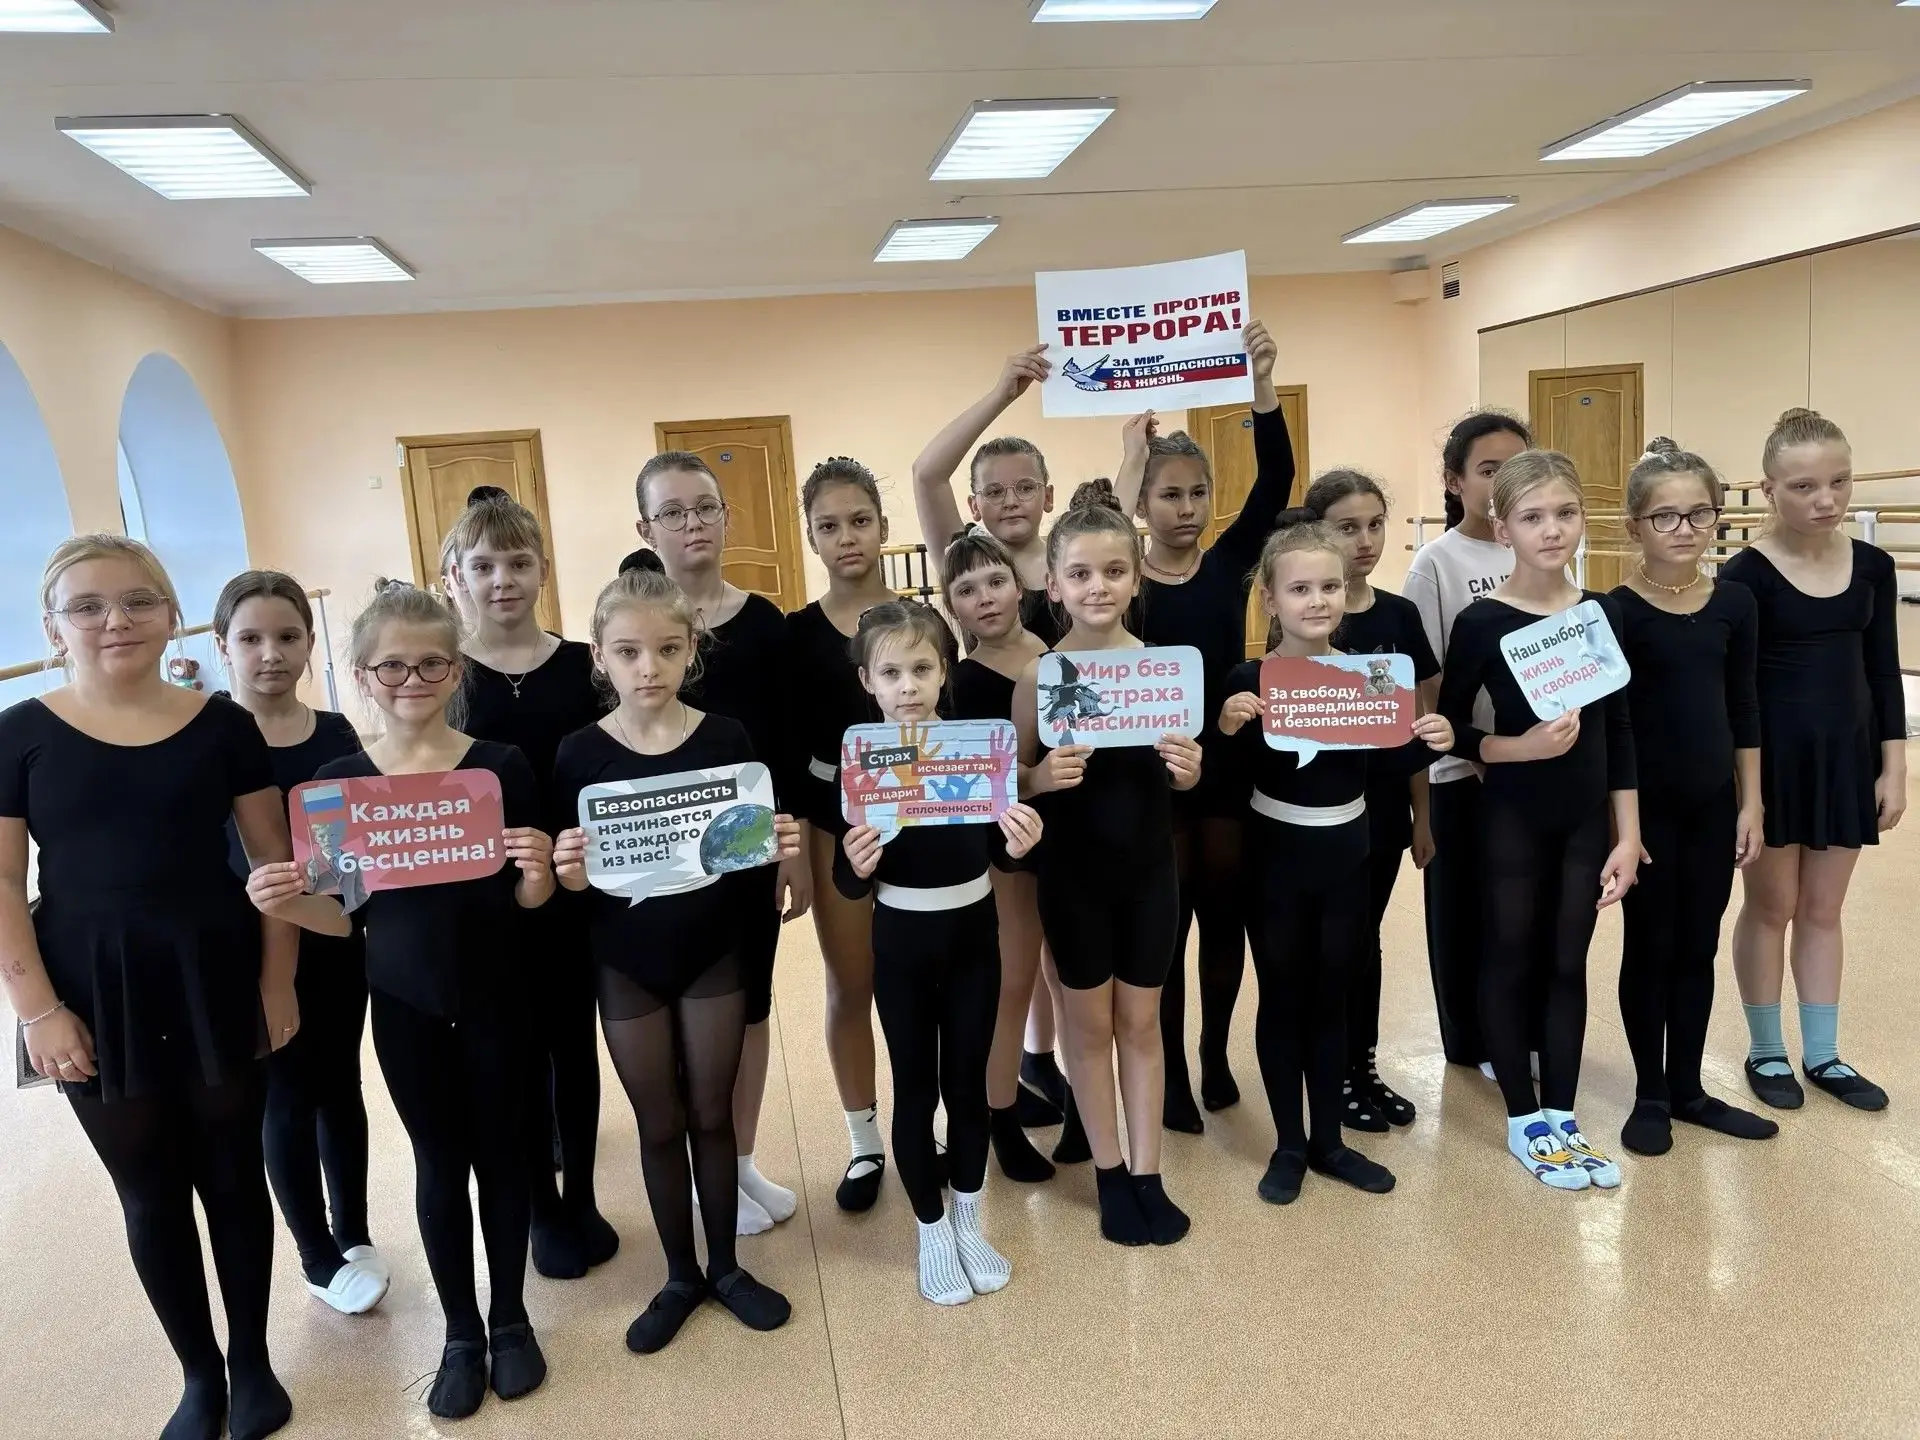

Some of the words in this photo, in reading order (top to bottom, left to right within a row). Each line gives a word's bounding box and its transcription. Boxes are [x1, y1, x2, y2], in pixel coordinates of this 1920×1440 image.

[1057, 305, 1146, 322] ВМЕСТЕ
[1153, 290, 1241, 316] ПРОТИВ
[1058, 308, 1242, 347] ТЕРРОРА!
[1112, 358, 1130, 367] ЗА
[1134, 354, 1165, 366] МИР
[1113, 369, 1131, 378] ЗА
[1134, 355, 1241, 376] БЕЗОПАСНОСТЬ
[1113, 380, 1132, 389] ЗА
[1135, 374, 1185, 388] ЖИЗНЬ
[1508, 641, 1541, 663] Наш
[1541, 623, 1585, 651] выбор
[1075, 661, 1131, 683] Мир
[1137, 658, 1181, 678] без
[1520, 655, 1565, 682] жизнь
[1530, 687, 1541, 701] и
[1543, 658, 1603, 697] свобода!
[1099, 686, 1184, 708] страха
[1269, 687, 1287, 700] За
[1291, 685, 1361, 700] свободу,
[1052, 718, 1067, 732] и
[1075, 708, 1190, 732] насилия!
[1270, 699, 1399, 718] справедливость
[1272, 718, 1281, 728] и
[1285, 712, 1397, 728] безопасность!
[868, 751, 911, 769] Страх
[917, 761, 970, 773] исчезает
[972, 761, 997, 773] там,
[594, 784, 733, 815] Безопасность
[860, 792, 880, 802] где
[882, 788, 919, 801] царит
[350, 798, 471, 824] Каждая
[905, 802, 992, 815] сплоченность!
[597, 808, 713, 836] начинается
[367, 824, 465, 847] жизнь
[600, 840, 611, 852] с
[615, 827, 700, 851] каждого
[338, 838, 496, 873] бесценна!
[602, 855, 625, 868] из
[631, 846, 670, 865] нас!
